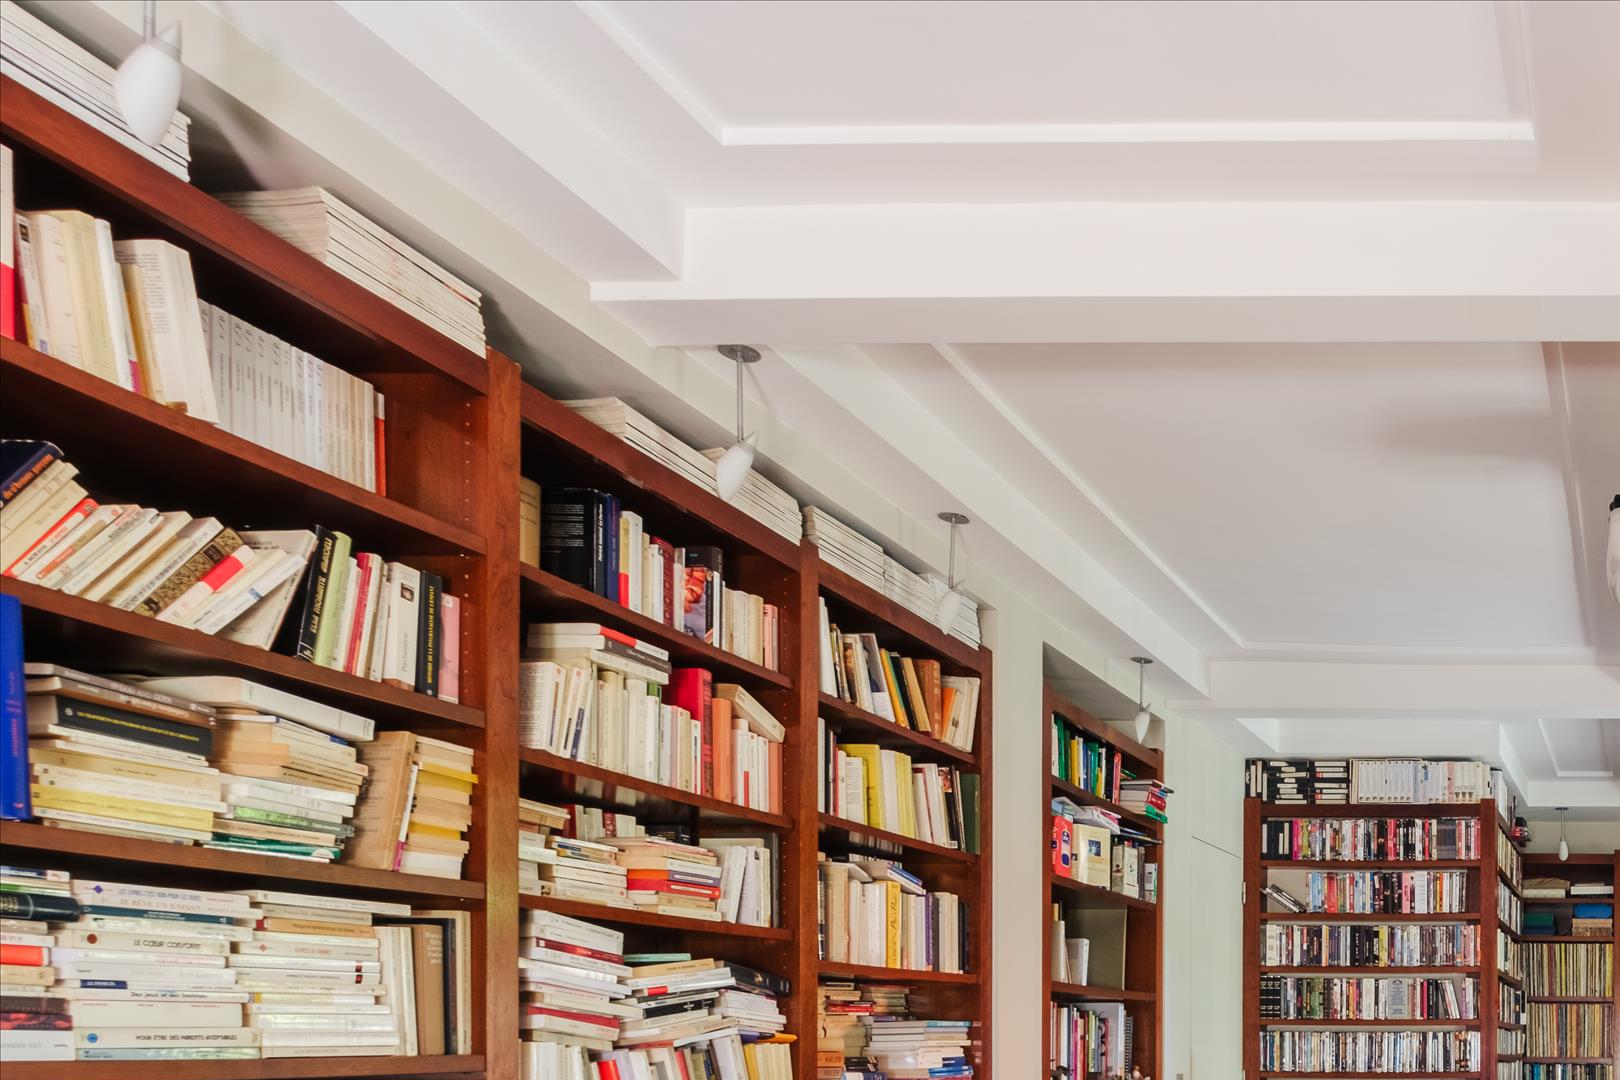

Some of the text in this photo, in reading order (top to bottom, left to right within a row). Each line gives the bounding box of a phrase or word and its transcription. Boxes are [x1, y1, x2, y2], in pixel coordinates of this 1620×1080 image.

[310, 538, 333, 634] ELSA MORANTE ARACOELI
